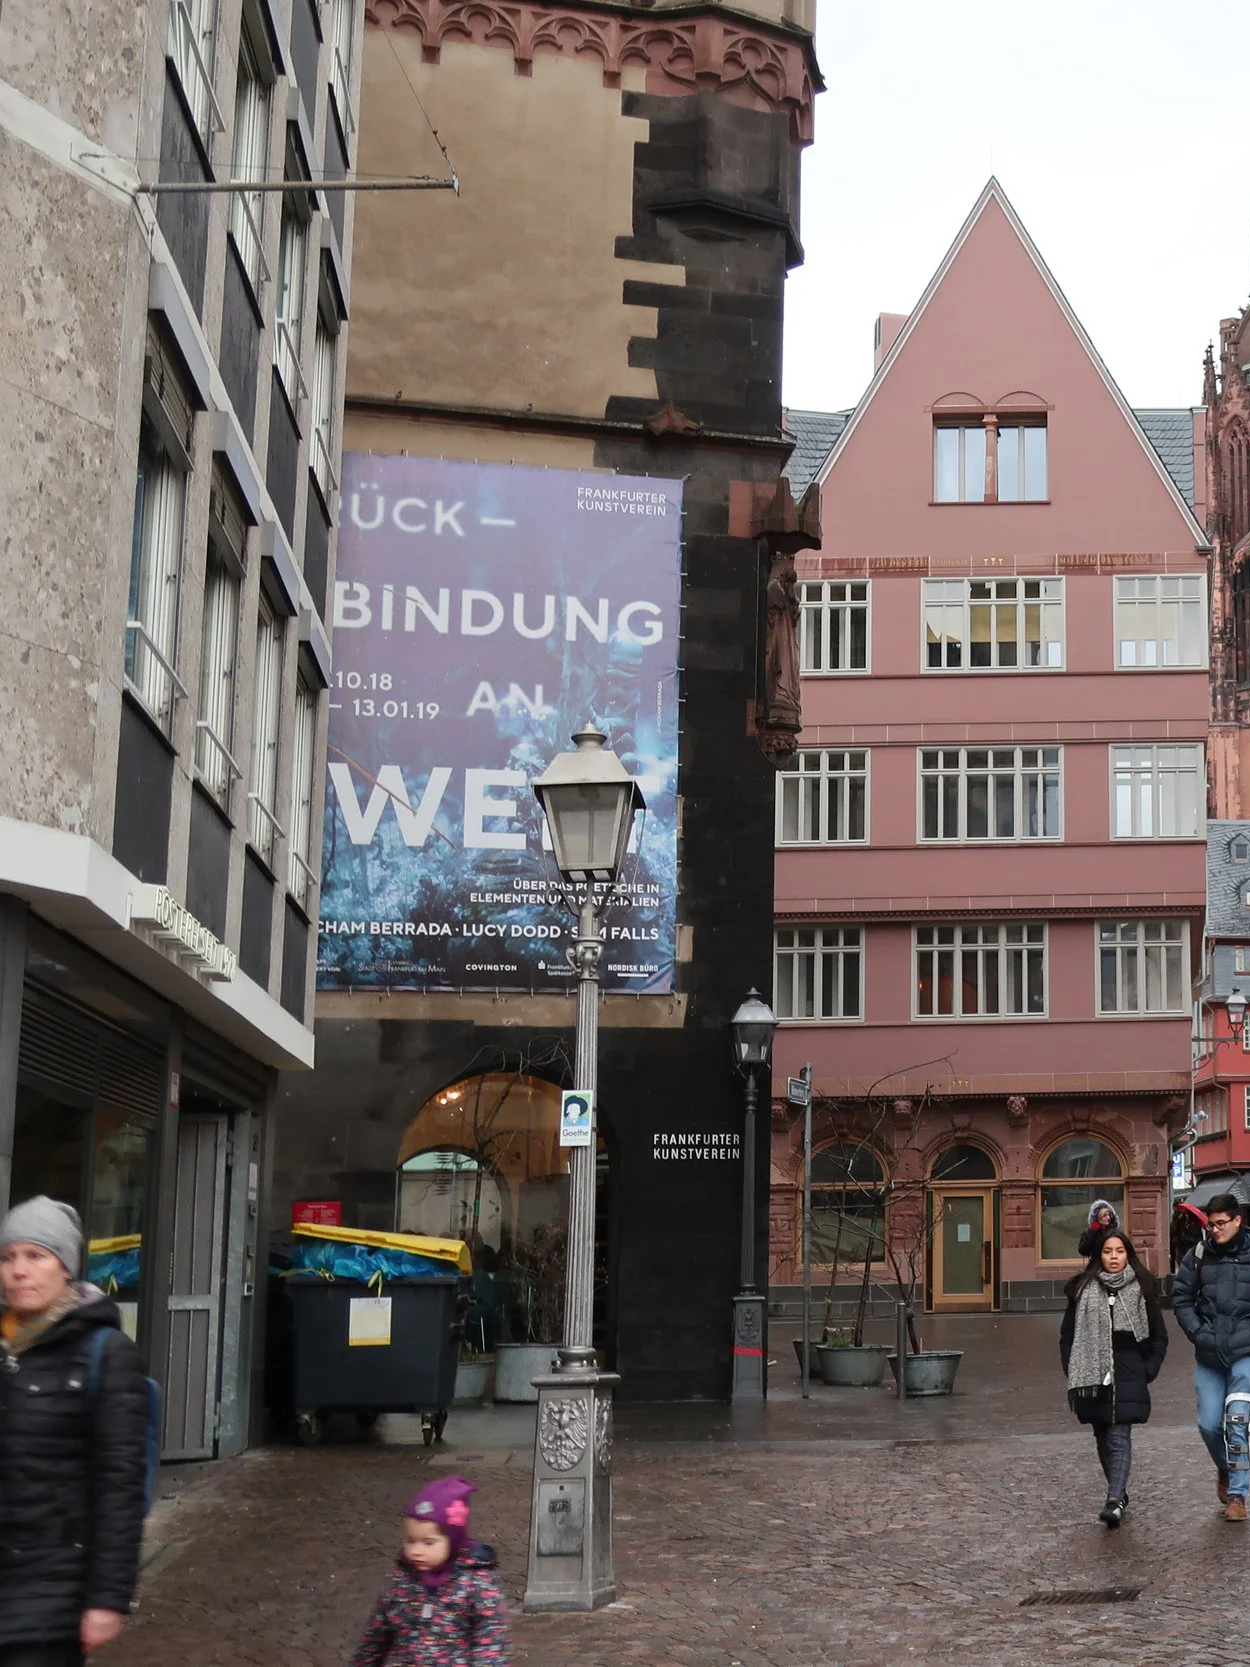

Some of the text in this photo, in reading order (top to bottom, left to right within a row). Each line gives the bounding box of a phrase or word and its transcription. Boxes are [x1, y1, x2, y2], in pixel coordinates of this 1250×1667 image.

[576, 486, 667, 504] FRANKFURTER
[338, 481, 466, 537] ÜCK
[576, 499, 667, 517] KUNSTVEREIN
[333, 581, 664, 647] BINDUNG
[465, 680, 545, 718] AN
[352, 698, 441, 720] 13.01.19
[513, 877, 546, 891] ÜBER
[647, 883, 660, 894] IN
[469, 891, 546, 905] ELEMENTEN
[369, 921, 453, 936] BERRADA
[462, 923, 507, 937] LUCY
[511, 924, 562, 938] DODD
[611, 926, 660, 940] FALLS
[465, 963, 518, 972] COVINGTON
[607, 963, 659, 973] NORDISK BÜRO
[562, 1128, 589, 1137] Goethe
[653, 1133, 740, 1146] FRANKFURTER
[653, 1148, 740, 1160] KUNSTVEREIN
